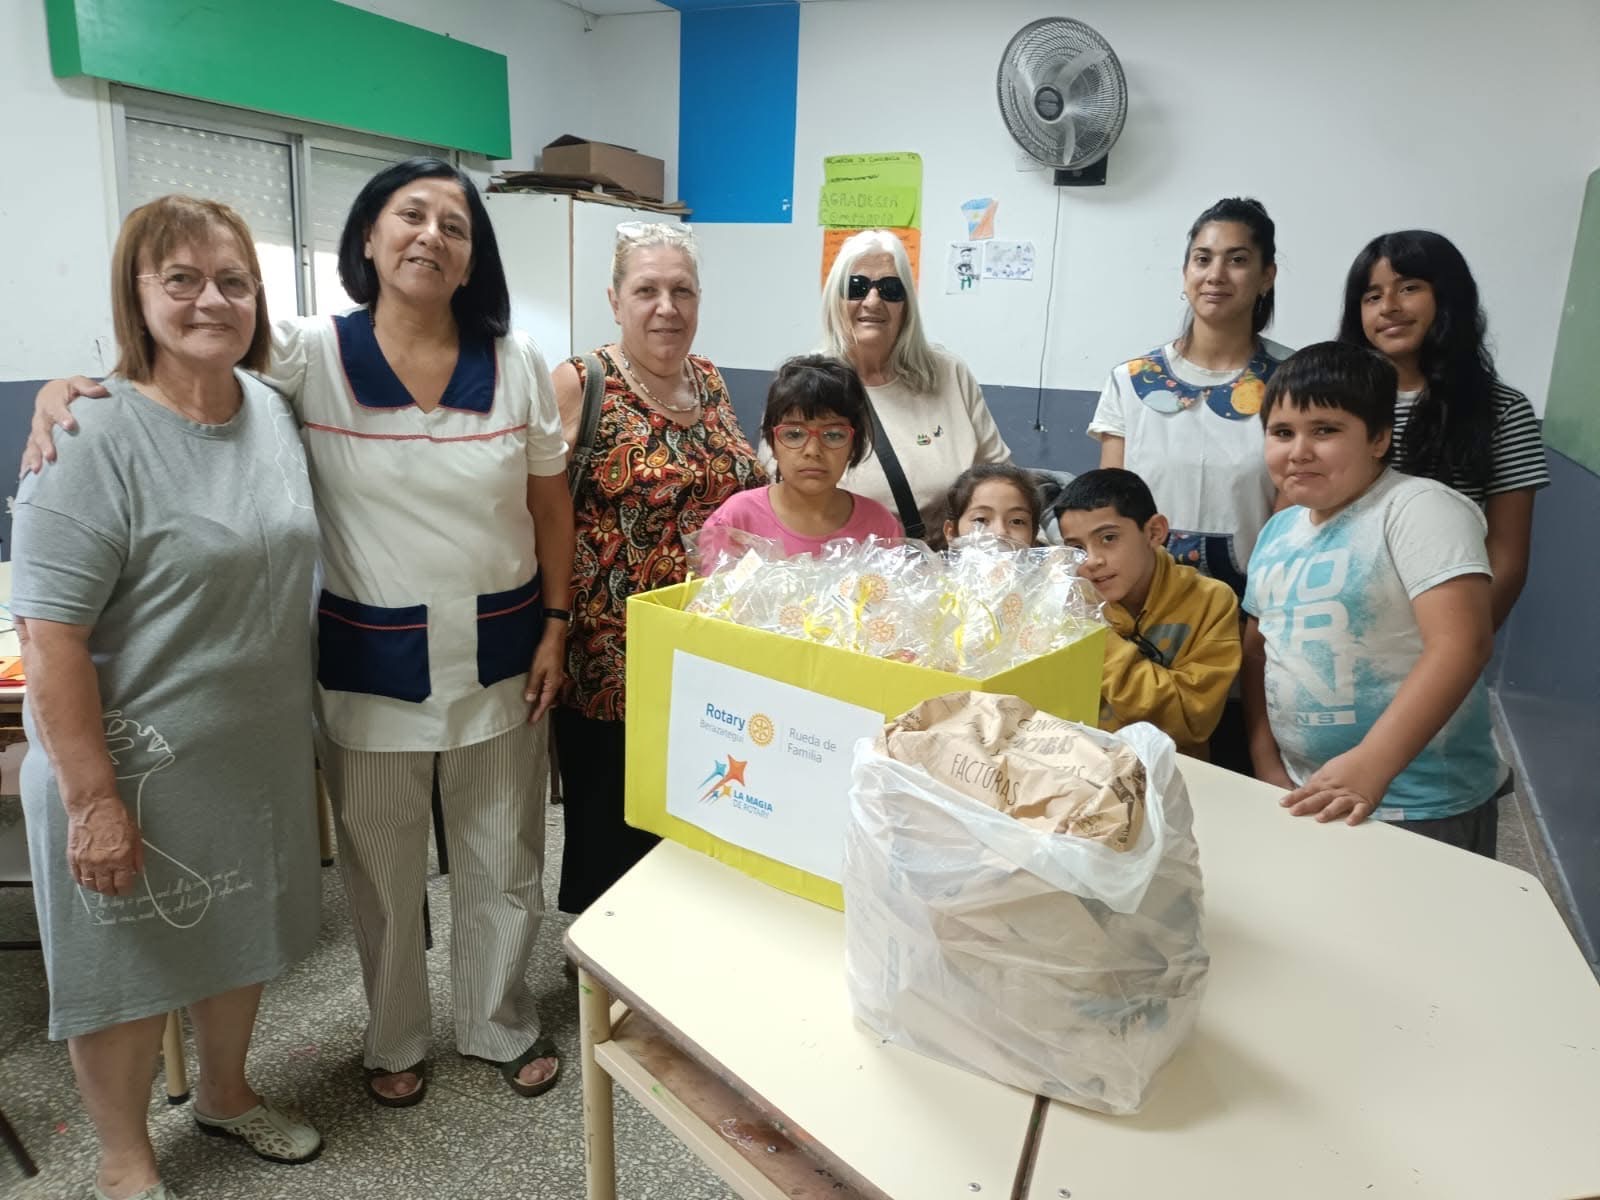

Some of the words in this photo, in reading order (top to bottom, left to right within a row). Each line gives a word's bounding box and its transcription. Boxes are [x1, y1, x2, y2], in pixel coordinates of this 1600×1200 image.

[706, 702, 746, 731] Rotary
[789, 727, 821, 747] Rueda
[823, 739, 837, 752] de
[787, 743, 822, 763] Familia
[951, 753, 1021, 806] FACTURAS
[733, 799, 742, 809] DE
[734, 790, 744, 801] LA
[746, 794, 773, 812] MAGIA
